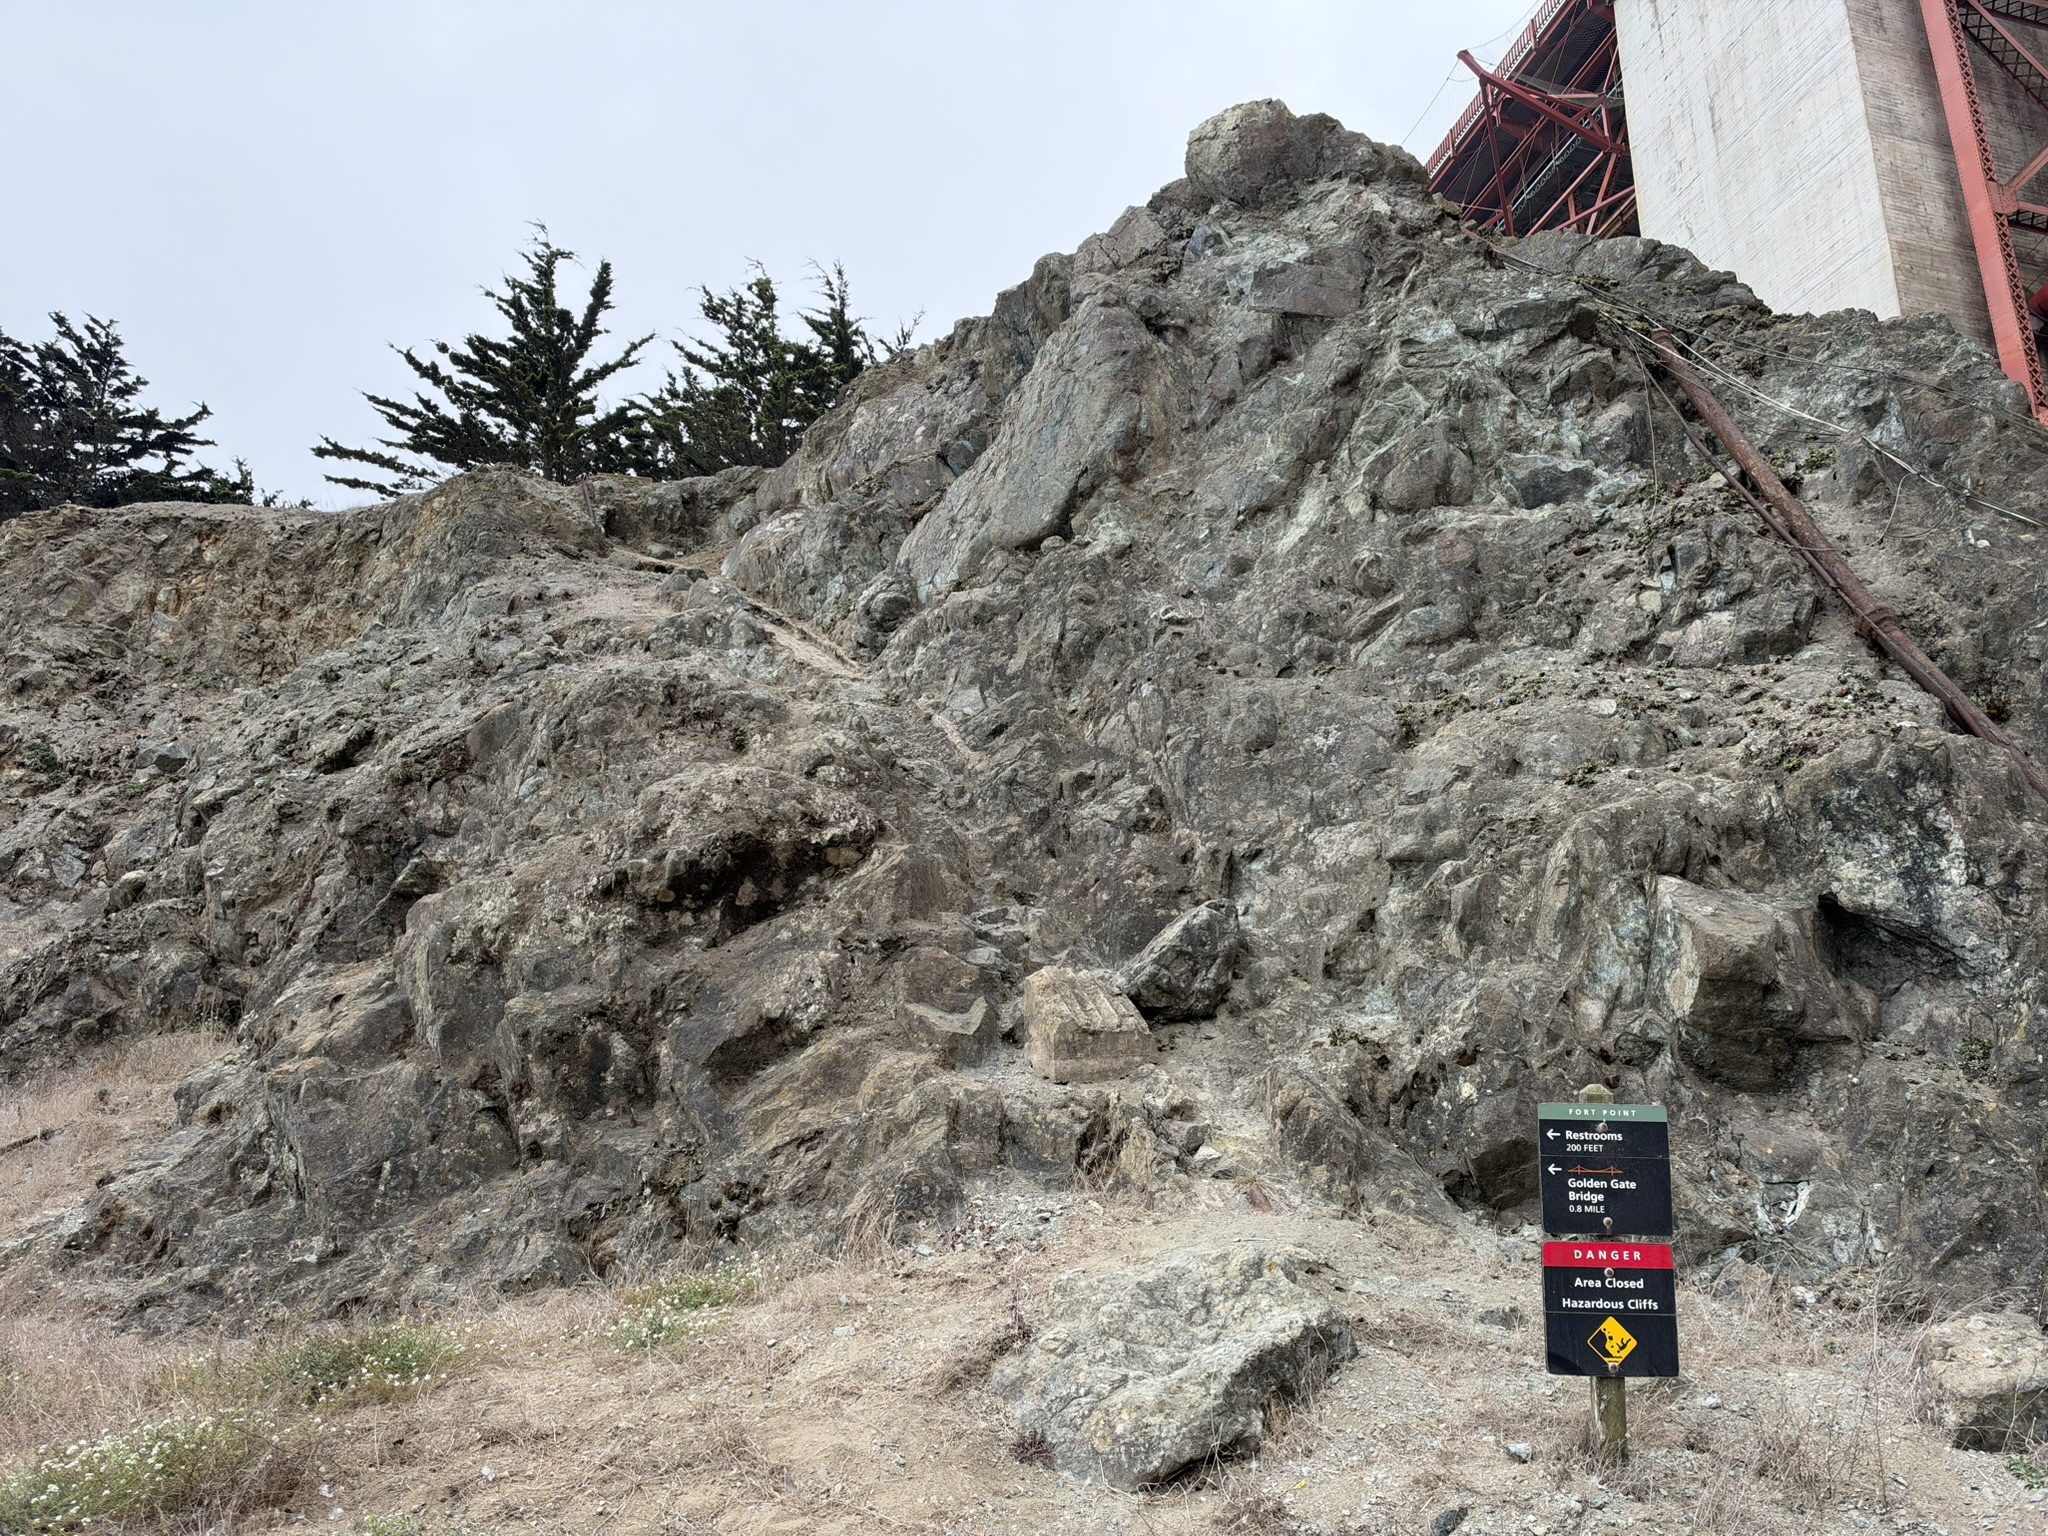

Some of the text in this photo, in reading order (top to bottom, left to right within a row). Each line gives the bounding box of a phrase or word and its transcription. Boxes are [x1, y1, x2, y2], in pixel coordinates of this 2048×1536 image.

[1602, 1109, 1636, 1117] POINT
[1565, 1130, 1623, 1141] Restrooms
[1566, 1143, 1604, 1152] 200 FEET
[1567, 1178, 1637, 1189] Golden Gate
[1568, 1191, 1605, 1203] Bridge
[1568, 1205, 1605, 1213] 0.8 MILE
[1573, 1249, 1641, 1261] DANGER
[1574, 1277, 1644, 1289] Area Closed
[1562, 1298, 1659, 1310] Hazardous Cliffs
